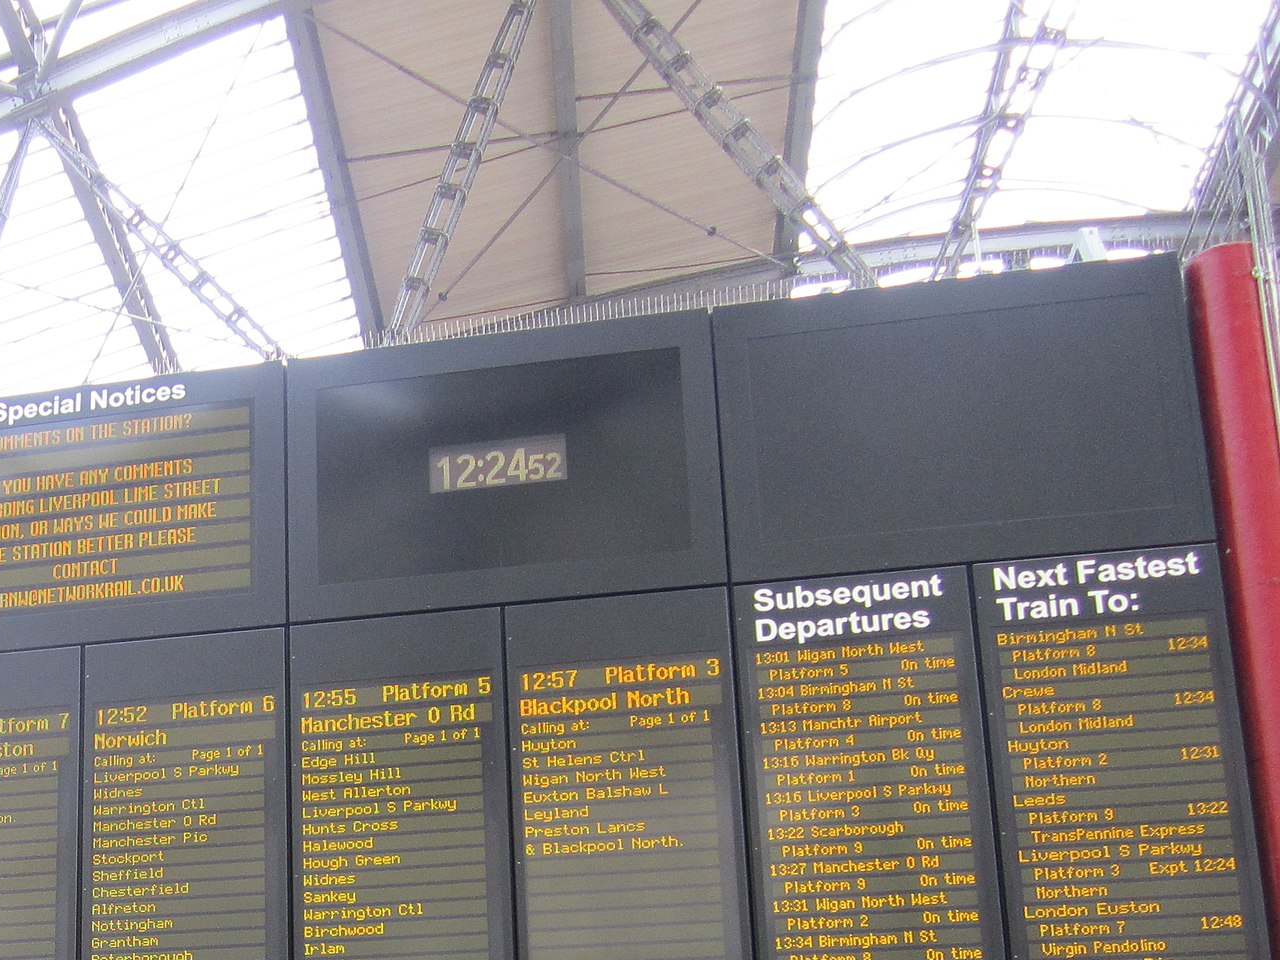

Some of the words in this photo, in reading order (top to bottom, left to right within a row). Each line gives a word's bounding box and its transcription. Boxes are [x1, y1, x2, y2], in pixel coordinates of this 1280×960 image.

[90, 383, 186, 410] Notices
[66, 426, 85, 443] ON
[91, 422, 117, 440] THE
[123, 413, 192, 437] STATION?
[2, 477, 30, 495] YOU
[36, 472, 73, 491] HAVE
[79, 469, 108, 486] ANY
[114, 459, 192, 482] COMMENTS
[39, 491, 119, 514] LIVERPOOL
[124, 485, 157, 503] LIME
[164, 478, 221, 499] STREET
[30, 520, 47, 536] OR
[53, 515, 93, 534] WAYS
[99, 512, 119, 528] WE
[124, 506, 172, 525] COULD
[177, 502, 216, 519] MAKE
[13, 540, 71, 562] STATION
[78, 534, 133, 554] BETTER
[139, 527, 196, 548] PLEASE
[52, 558, 118, 578] CONTACT
[993, 560, 1068, 591] Next
[1076, 551, 1200, 584] Fastest
[753, 574, 943, 612] Subsequent
[996, 592, 1079, 623] Train
[1089, 589, 1140, 615] To:
[754, 609, 931, 644] Departures
[755, 651, 790, 665] 13:01
[798, 648, 836, 663] Wigan
[842, 644, 882, 659] North
[888, 640, 924, 654] West
[1011, 645, 1078, 662] Platform
[1167, 636, 1209, 651] 12:34
[522, 670, 578, 691] 12:57
[605, 663, 696, 685] Platform
[706, 659, 720, 676] 3
[303, 689, 356, 709] 12:55
[383, 682, 467, 702] Platform
[478, 677, 491, 694] 5
[520, 693, 617, 717] Blackpool
[627, 688, 690, 707] North
[58, 713, 69, 729] 7
[96, 707, 147, 724] 12:52
[172, 700, 253, 720] Platform
[262, 696, 275, 712] 6
[301, 711, 417, 734] Manchester
[451, 705, 475, 722] Rd
[94, 730, 167, 750] Norwich
[524, 805, 589, 821] Leyland
[1031, 827, 1133, 843] TransPennine
[1141, 821, 1206, 837] Express
